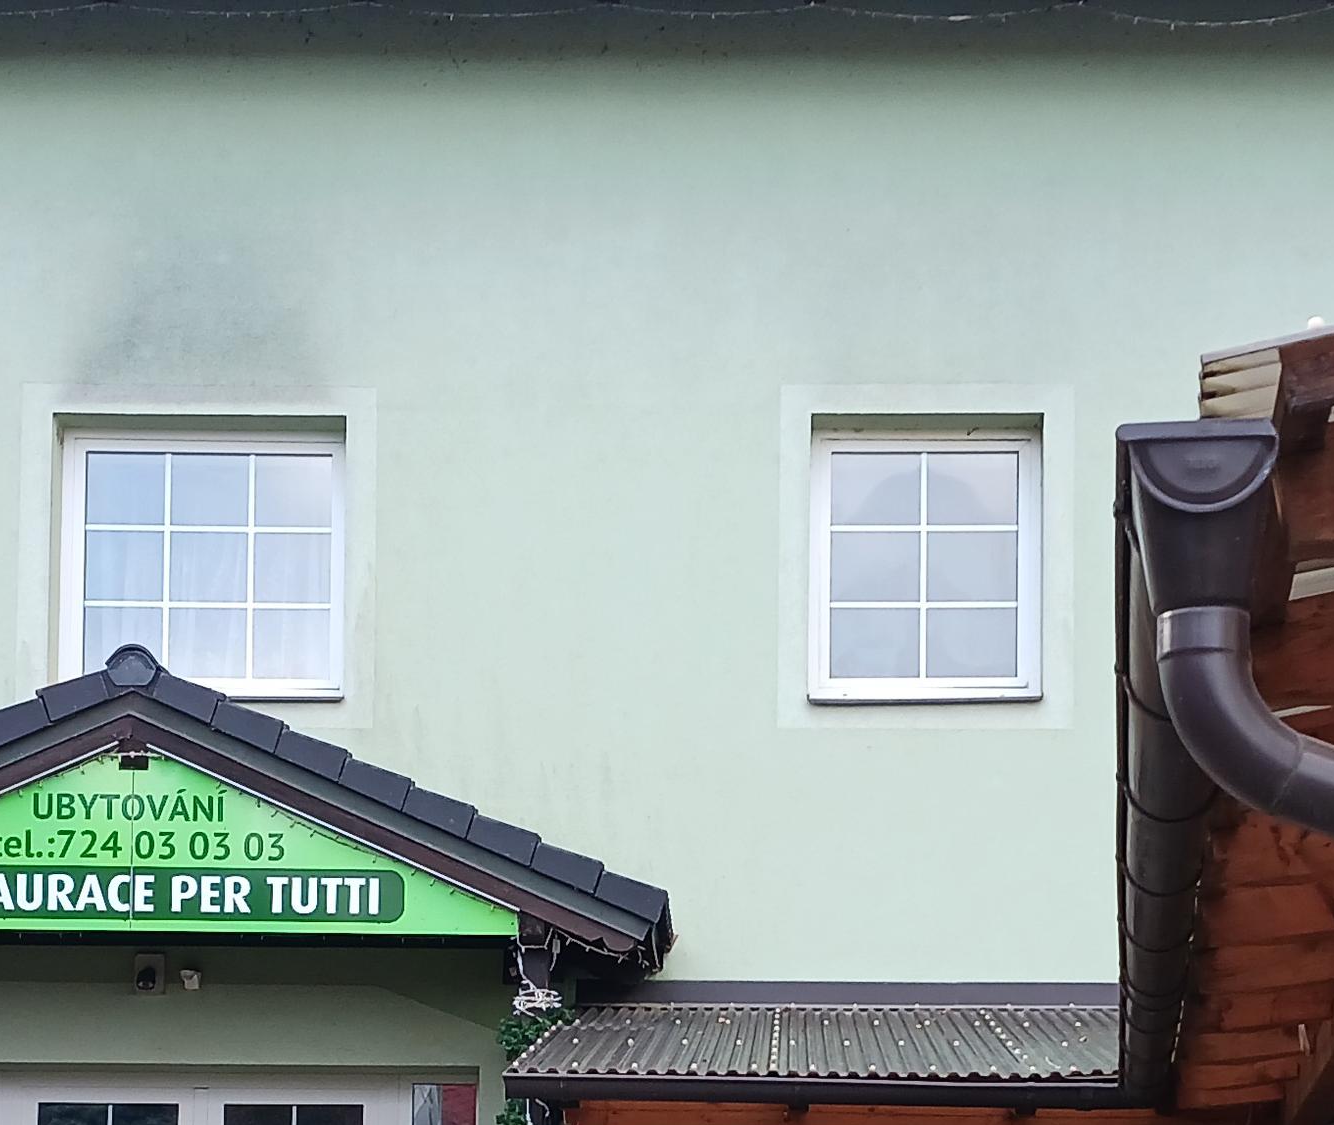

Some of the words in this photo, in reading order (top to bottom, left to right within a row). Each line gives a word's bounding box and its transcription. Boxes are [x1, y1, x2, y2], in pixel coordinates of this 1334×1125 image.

[33, 789, 228, 822] UBYTOVÁNÍ
[135, 831, 176, 860] 03
[189, 831, 231, 861] 03
[244, 832, 285, 861] 03
[171, 875, 252, 914] PER
[267, 877, 380, 915] TUTTI
